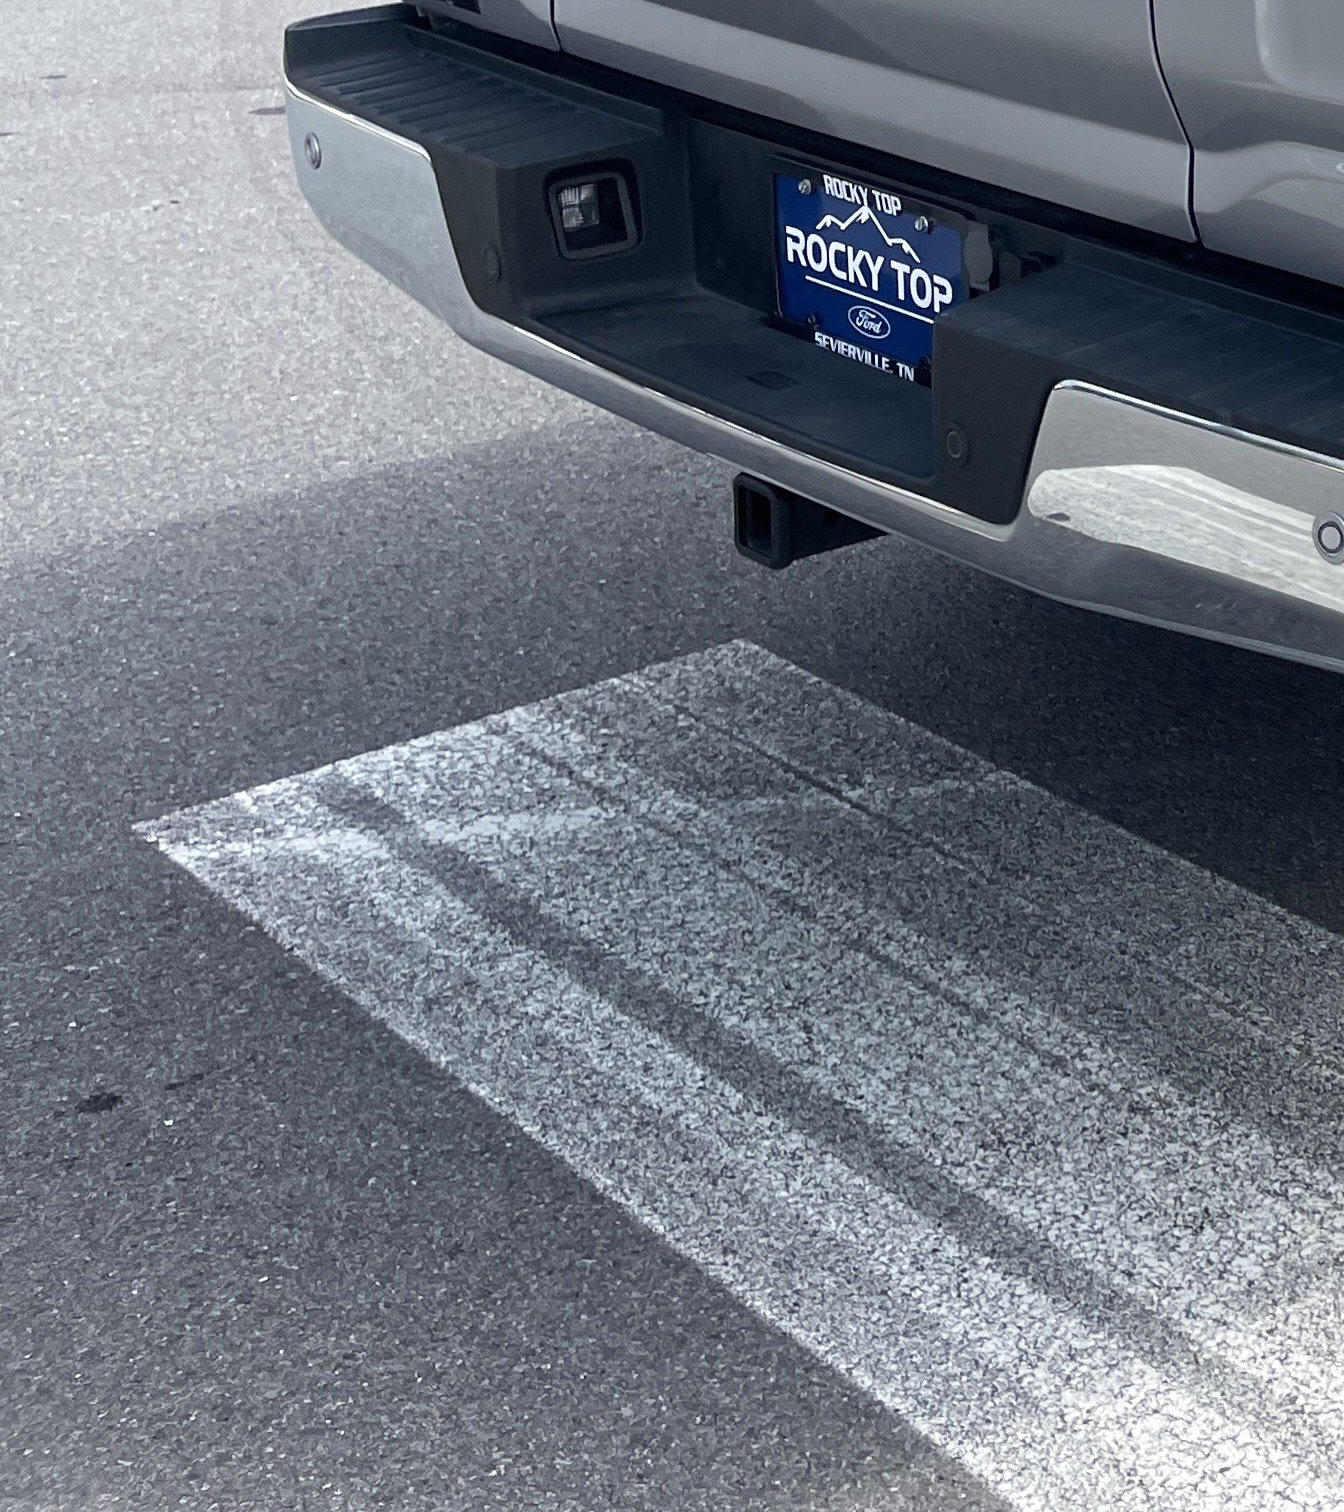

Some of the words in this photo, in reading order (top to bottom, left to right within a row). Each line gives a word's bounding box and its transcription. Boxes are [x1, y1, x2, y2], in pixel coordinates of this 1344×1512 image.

[823, 174, 868, 207] ROCKY
[872, 189, 902, 216] TOP
[785, 225, 885, 291] ROCKY
[890, 259, 953, 313] TOP
[856, 309, 882, 334] Ford
[896, 362, 915, 382] TN
